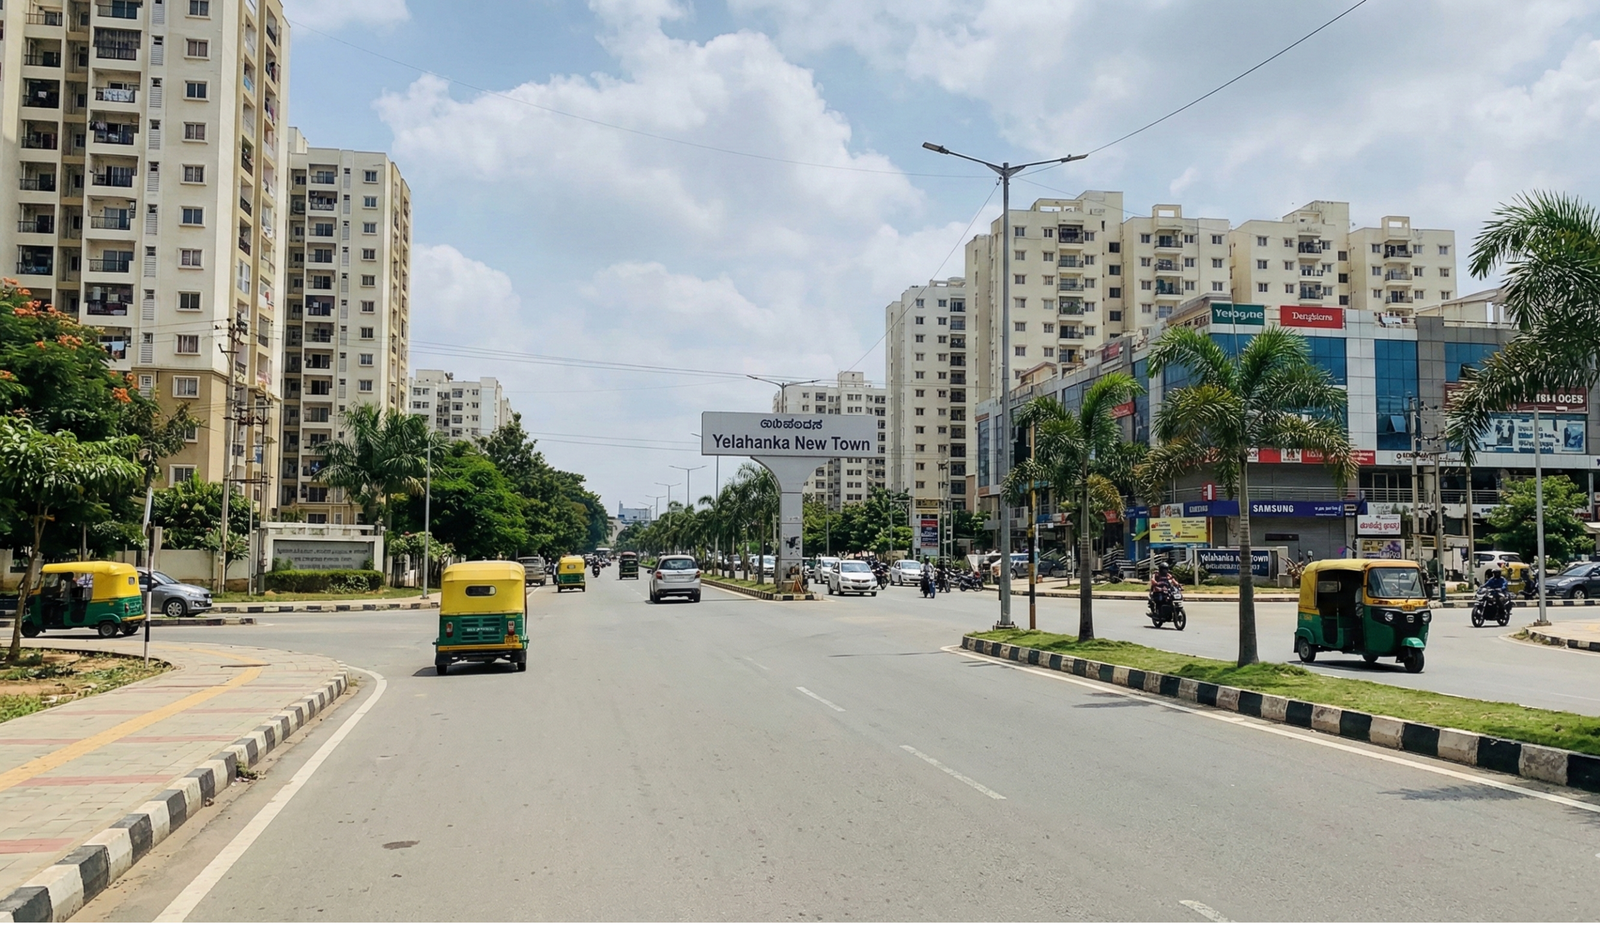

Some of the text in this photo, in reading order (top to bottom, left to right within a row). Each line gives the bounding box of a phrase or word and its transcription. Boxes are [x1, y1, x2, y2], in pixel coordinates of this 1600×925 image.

[713, 434, 870, 451] Yelahanka New Town
[1252, 504, 1294, 513] SAMSUNG
